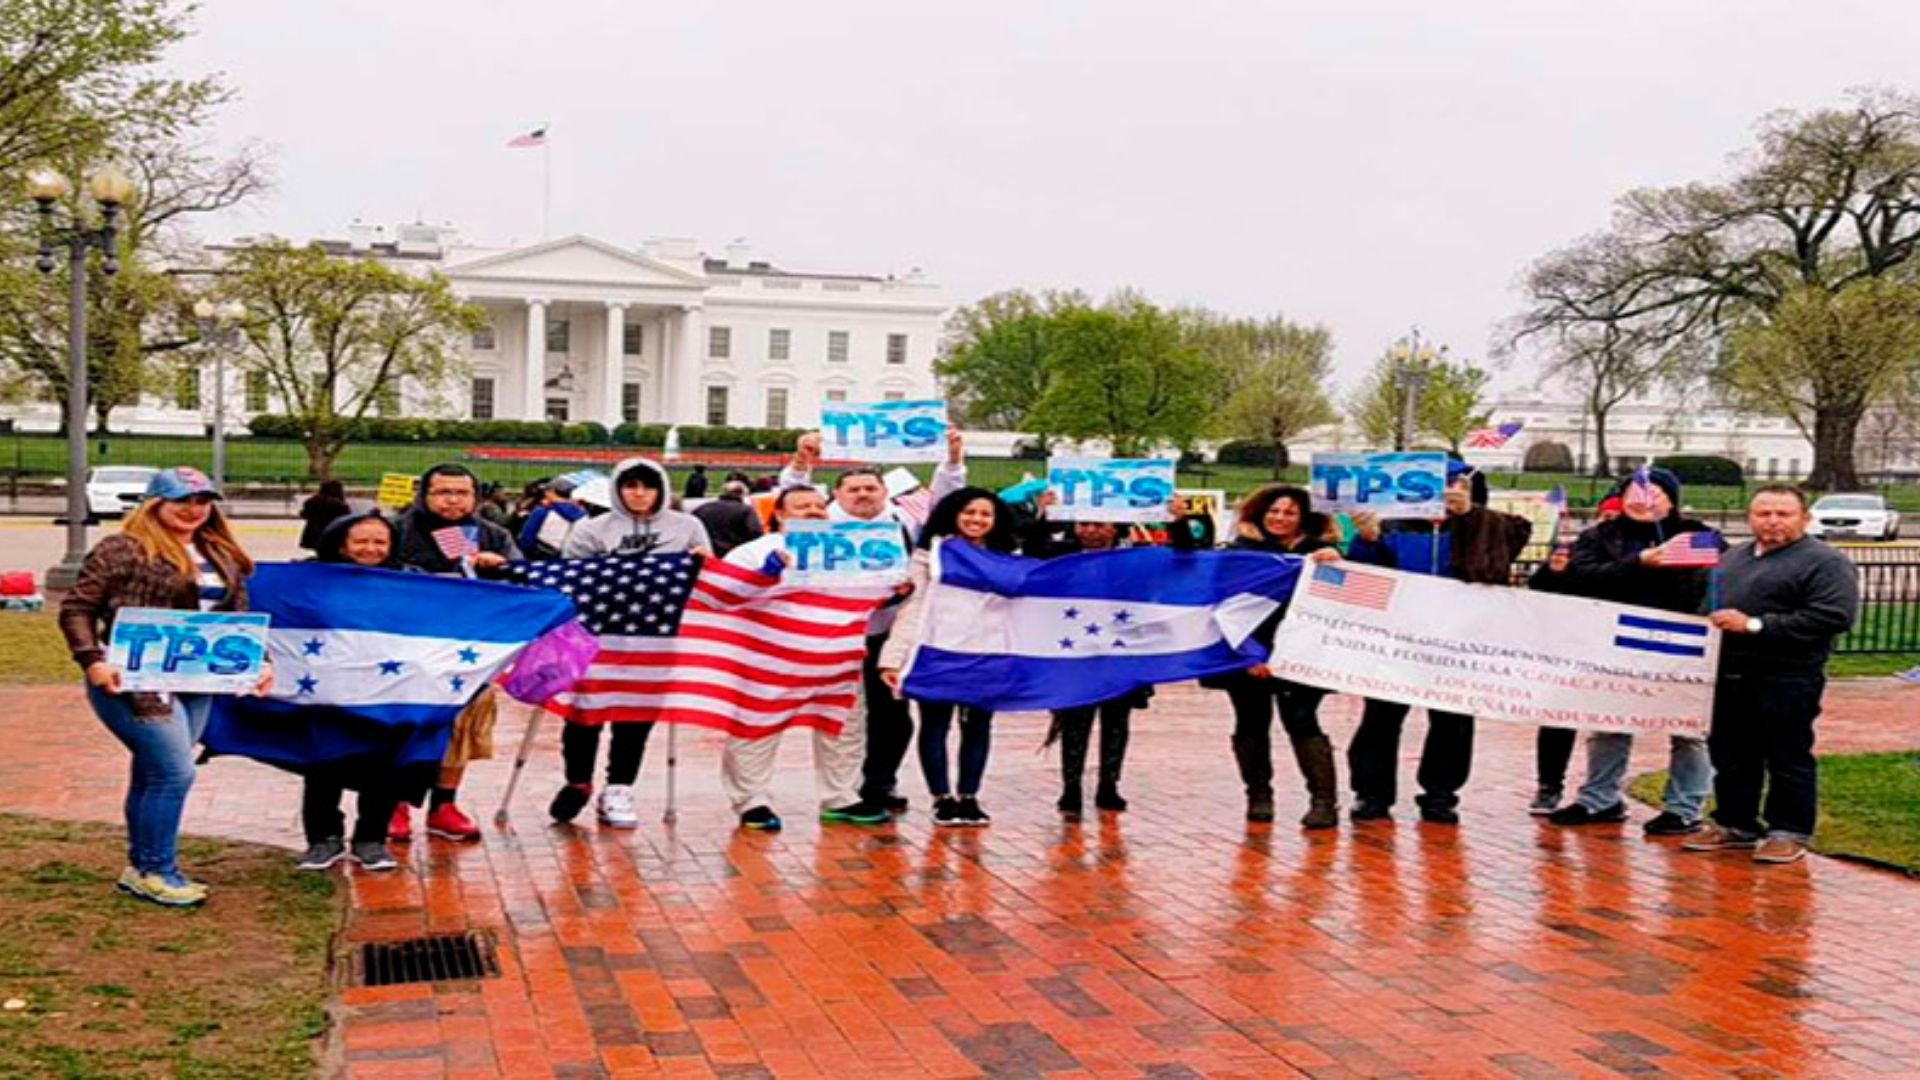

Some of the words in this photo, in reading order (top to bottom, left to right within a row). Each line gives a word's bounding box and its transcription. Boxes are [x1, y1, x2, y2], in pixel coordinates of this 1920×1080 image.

[821, 411, 947, 447] TPS
[1050, 468, 1172, 508] TPS
[1313, 465, 1444, 502] TPS
[785, 531, 902, 570] TPS
[115, 623, 263, 674] TPS
[1510, 702, 1626, 726] HONDURAS
